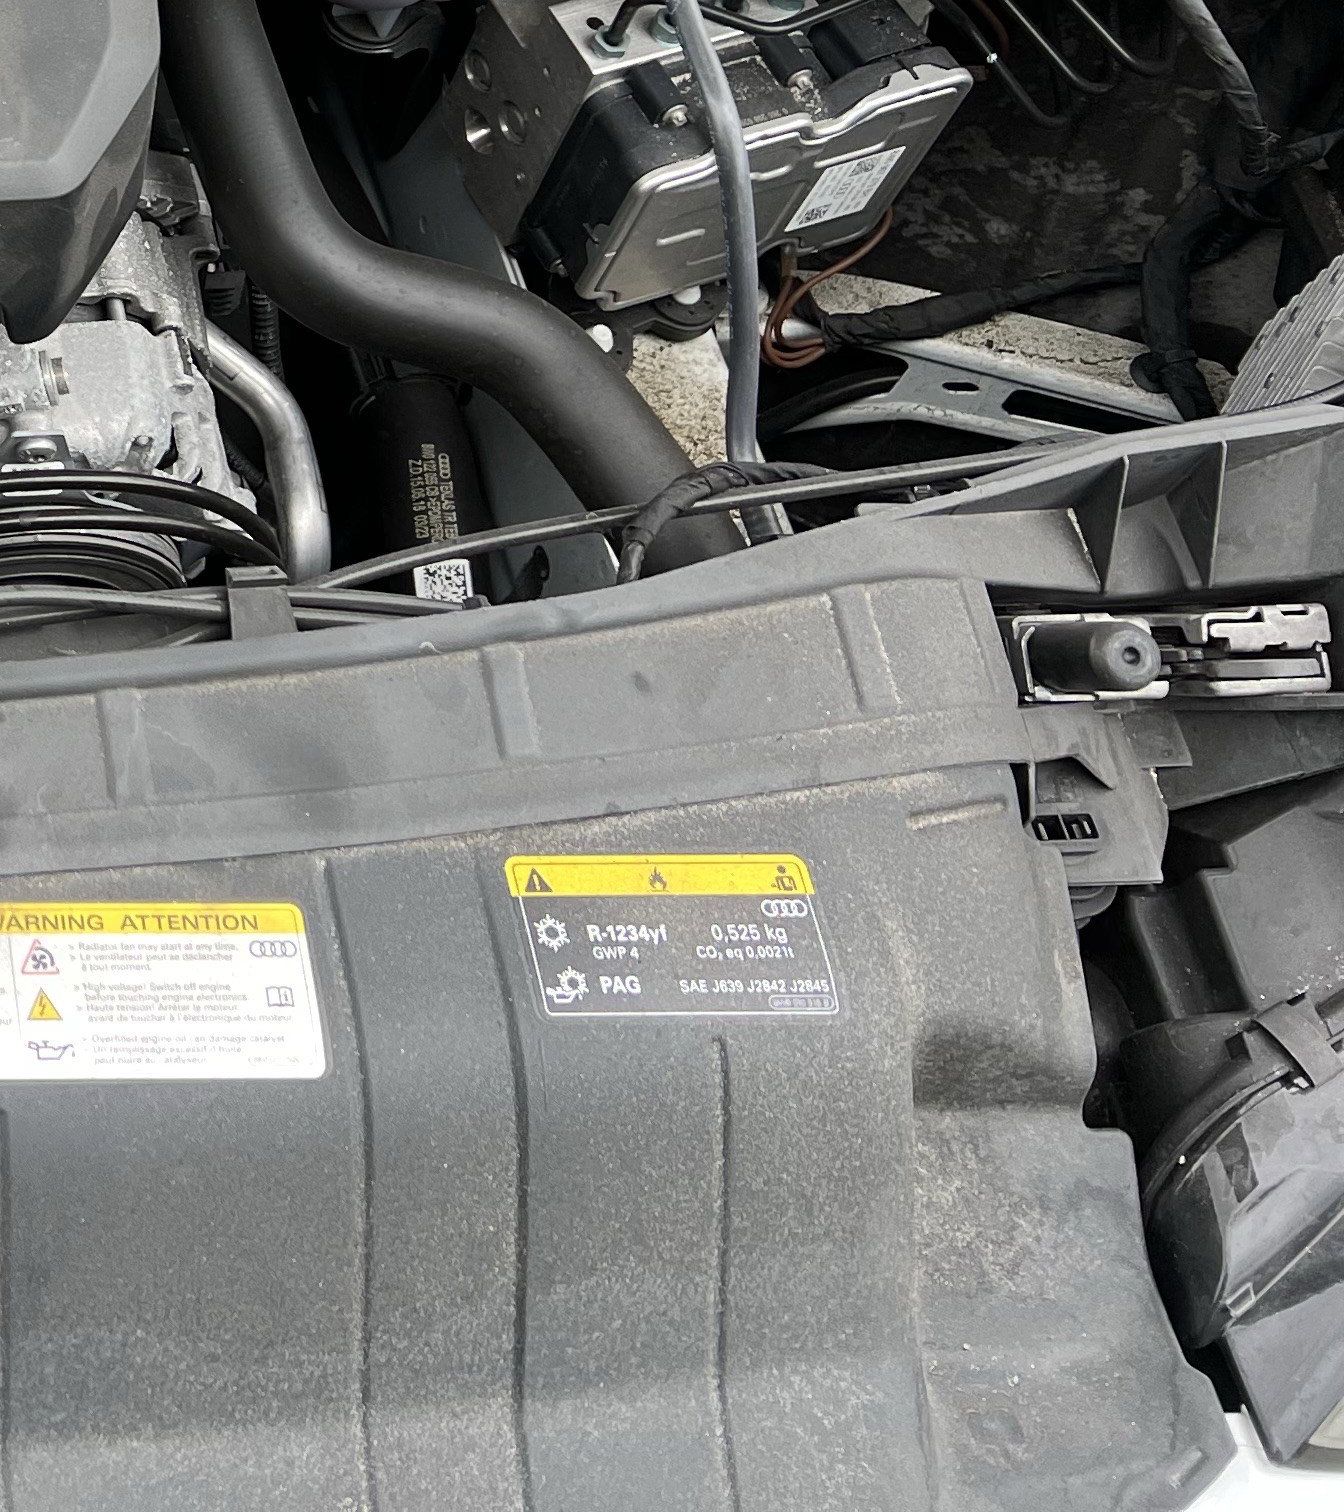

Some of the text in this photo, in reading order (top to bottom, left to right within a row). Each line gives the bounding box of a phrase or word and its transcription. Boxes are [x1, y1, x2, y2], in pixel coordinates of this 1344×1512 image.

[120, 914, 258, 931] ATTENTION
[586, 923, 788, 945] R-1234yf 0,525 kg
[593, 946, 627, 960] GWP
[630, 947, 640, 960] 4
[726, 948, 743, 961] eq
[599, 975, 830, 994] PAG SAE J639 J2842 J2845
